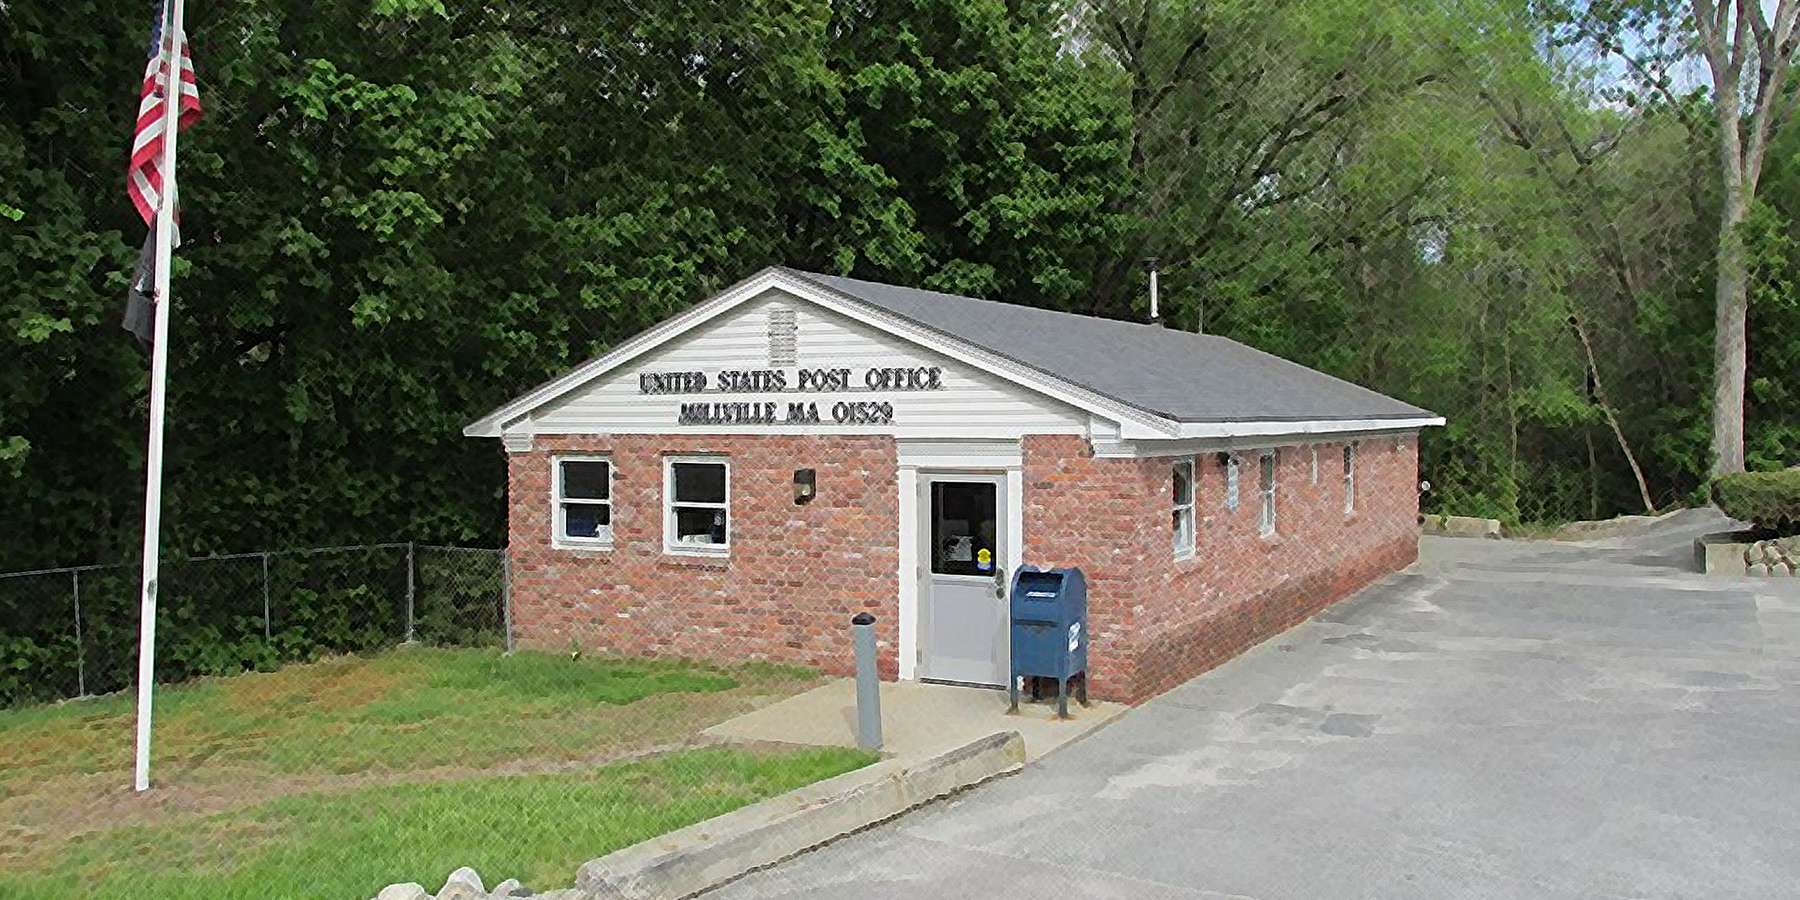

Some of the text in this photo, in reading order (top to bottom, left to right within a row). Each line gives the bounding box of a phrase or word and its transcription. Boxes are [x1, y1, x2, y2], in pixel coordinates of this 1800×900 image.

[640, 366, 942, 394] UNITED STATES POST OFFICE
[678, 401, 893, 425] MILLVILLE MA 01529
